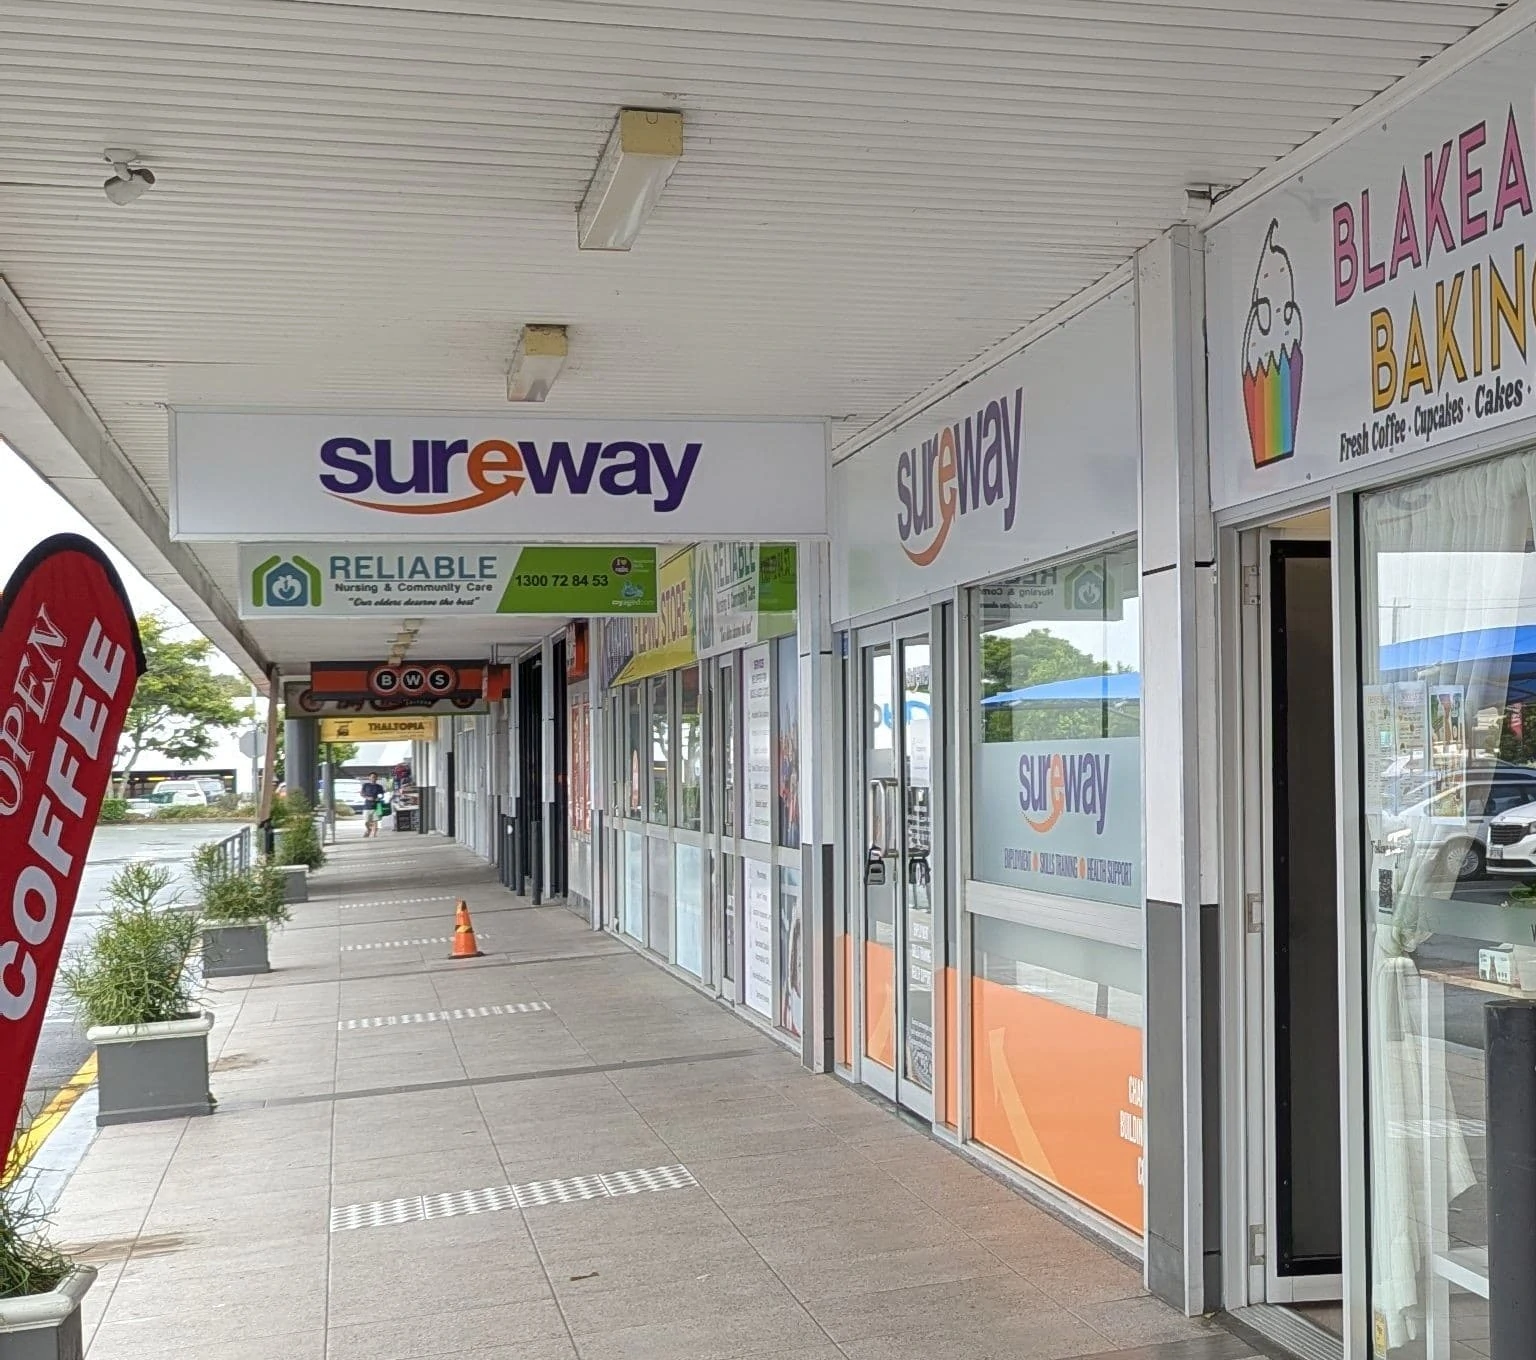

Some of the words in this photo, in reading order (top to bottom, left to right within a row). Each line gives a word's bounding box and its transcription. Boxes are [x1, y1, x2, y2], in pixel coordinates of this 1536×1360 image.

[1339, 424, 1369, 463] Fresh
[1371, 412, 1406, 454] Coffee
[1414, 391, 1464, 442] Cupcakes
[1474, 376, 1524, 421] Cakes
[319, 437, 702, 515] sureway
[896, 386, 1024, 566] sureway
[330, 556, 497, 579] RELIABLE
[335, 583, 378, 593] Nursing
[384, 583, 392, 592] &
[398, 583, 460, 593] Community
[467, 583, 492, 592] Care
[515, 575, 548, 587] 1300
[552, 575, 568, 587] 72
[572, 575, 588, 587] 84
[592, 575, 609, 587] 53
[439, 597, 454, 606] the
[661, 580, 688, 647] STORE
[382, 673, 444, 685] BWS
[1019, 753, 1110, 834] sureway
[0, 616, 126, 1021] COFFEE
[1107, 859, 1132, 887] SUPPORT
